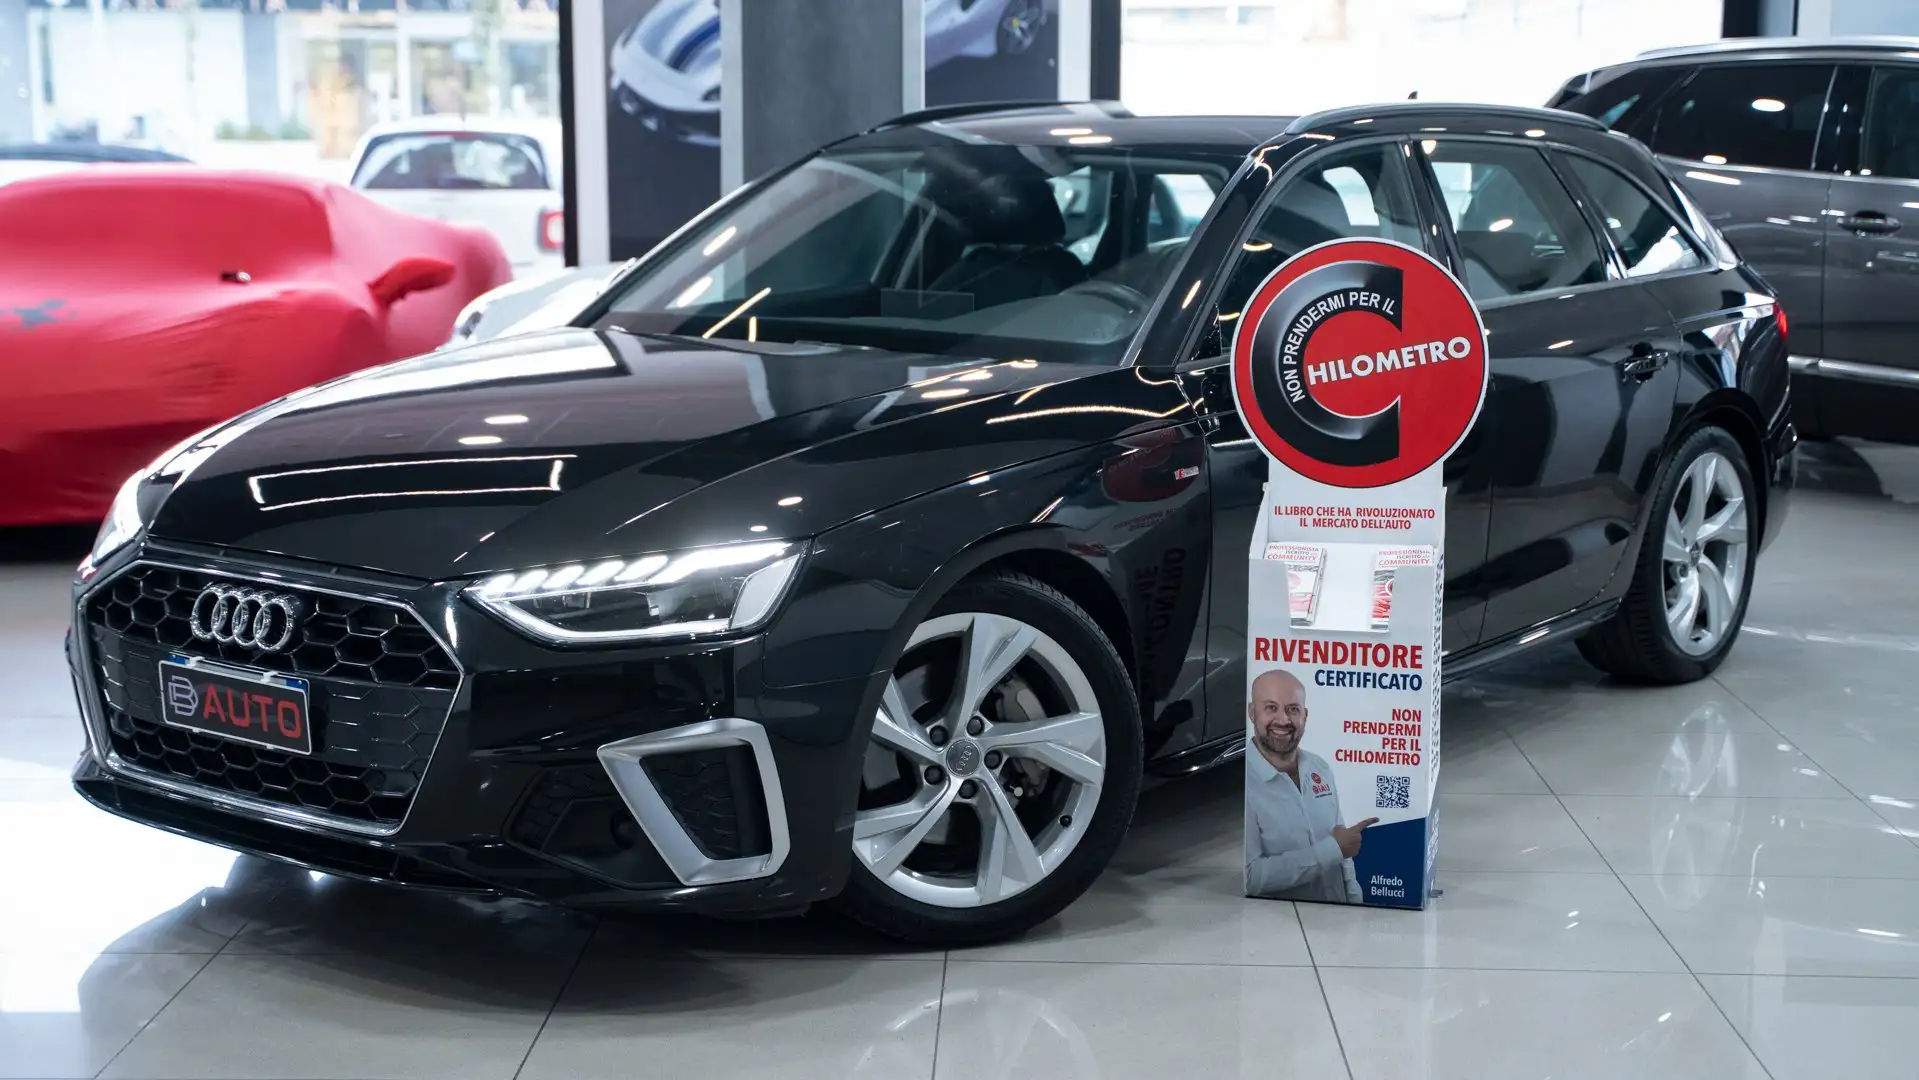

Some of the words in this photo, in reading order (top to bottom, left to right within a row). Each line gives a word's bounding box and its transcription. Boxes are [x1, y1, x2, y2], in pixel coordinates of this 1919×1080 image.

[1349, 291, 1381, 308] PER
[1382, 298, 1396, 316] IL
[1283, 293, 1345, 365] PRENDERMI
[1283, 369, 1305, 403] NON
[1274, 505, 1283, 516] IL
[1285, 506, 1314, 516] LIBRO
[1316, 506, 1335, 517] CHE
[1338, 507, 1351, 517] HA
[1356, 507, 1435, 519] RIVOLUZIONATO
[1299, 518, 1308, 528] IL
[1312, 518, 1359, 529] MERCATO
[1255, 637, 1423, 669] RIVENDITORE
[1314, 669, 1423, 691] CERTIFICATO
[203, 684, 301, 738] AUTO
[1392, 708, 1421, 722] NON
[1343, 720, 1421, 737] PRENDERMI
[1382, 737, 1406, 750] PER
[1410, 738, 1421, 751] IL
[1335, 749, 1421, 766] CHILOMETRO
[1371, 874, 1403, 887] Alfredo
[1371, 886, 1405, 898] Bellucci
